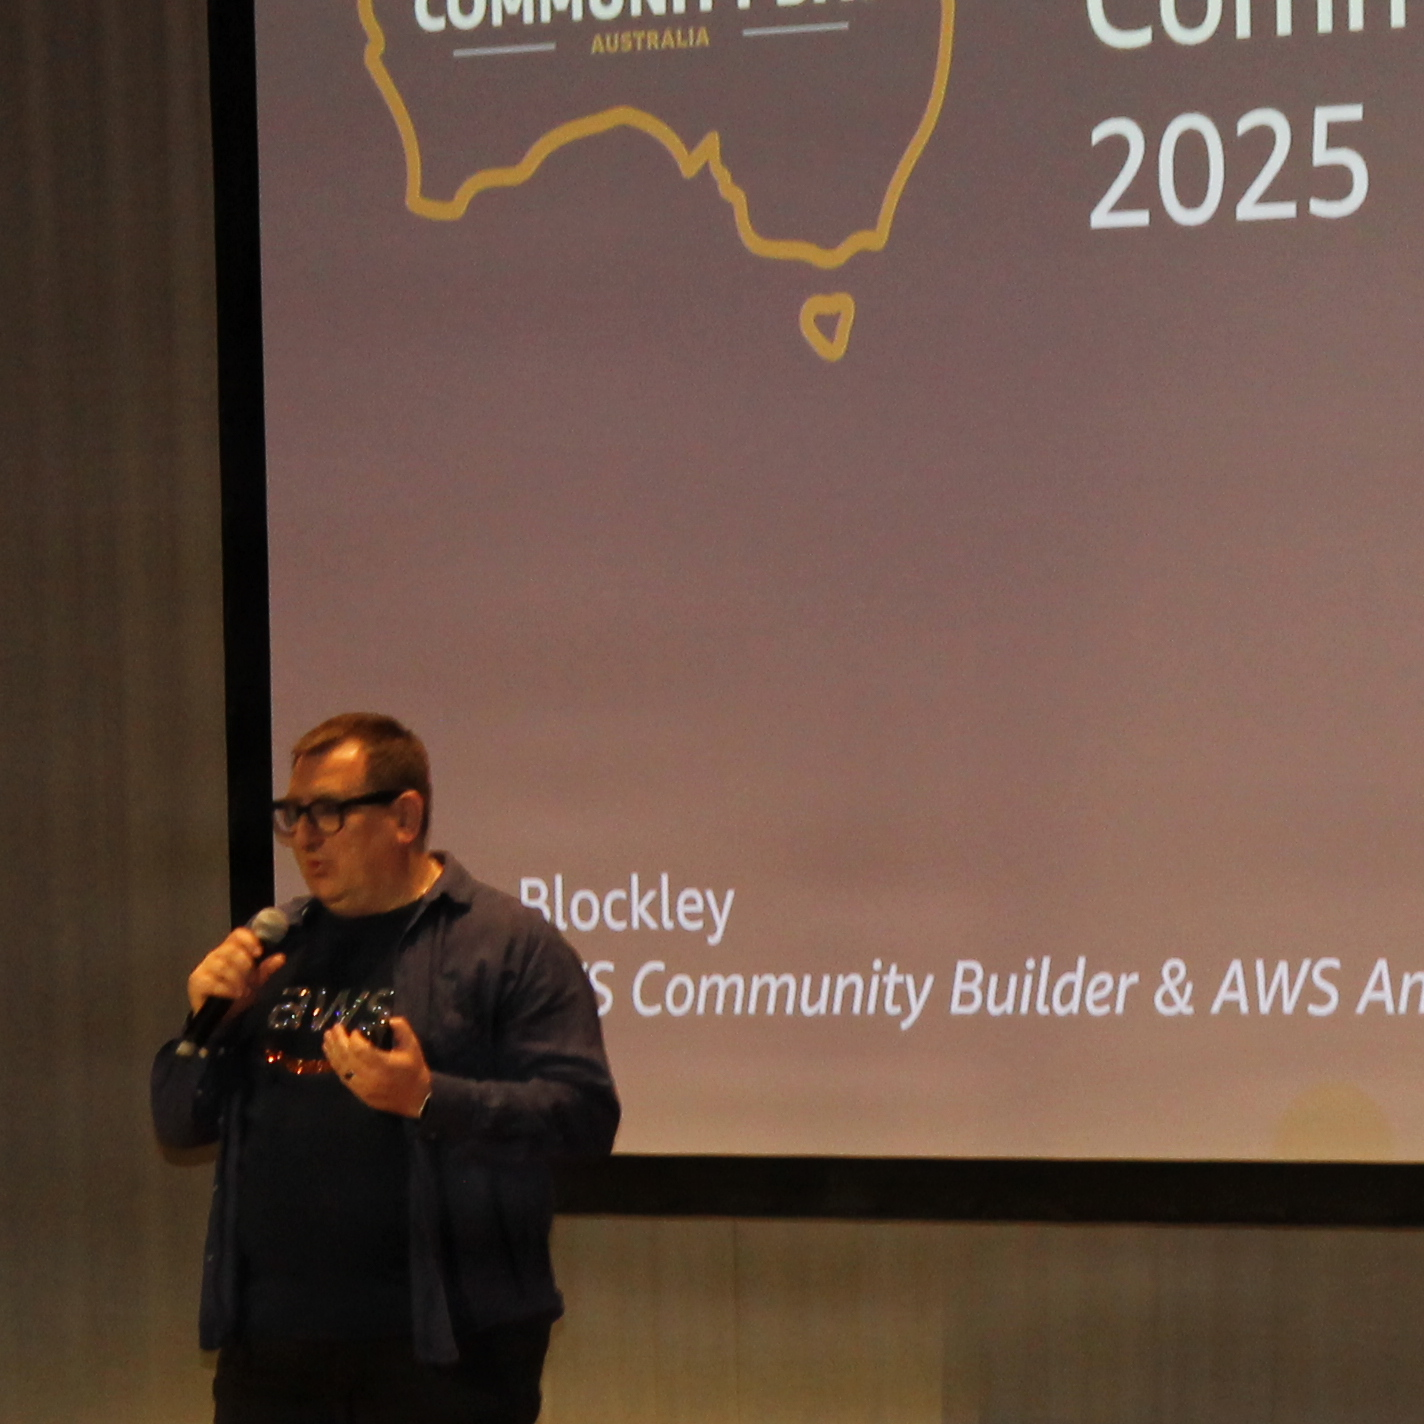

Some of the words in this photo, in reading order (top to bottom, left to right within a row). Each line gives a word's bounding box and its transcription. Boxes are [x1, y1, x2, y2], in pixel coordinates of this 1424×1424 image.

[591, 27, 711, 54] AUSTRALIA
[1089, 103, 1370, 229] 2025
[520, 872, 735, 946] Blockley
[632, 958, 935, 1031] Community
[950, 955, 1140, 1017] Builder
[1153, 956, 1194, 1017] &
[1210, 957, 1342, 1017] AWS
